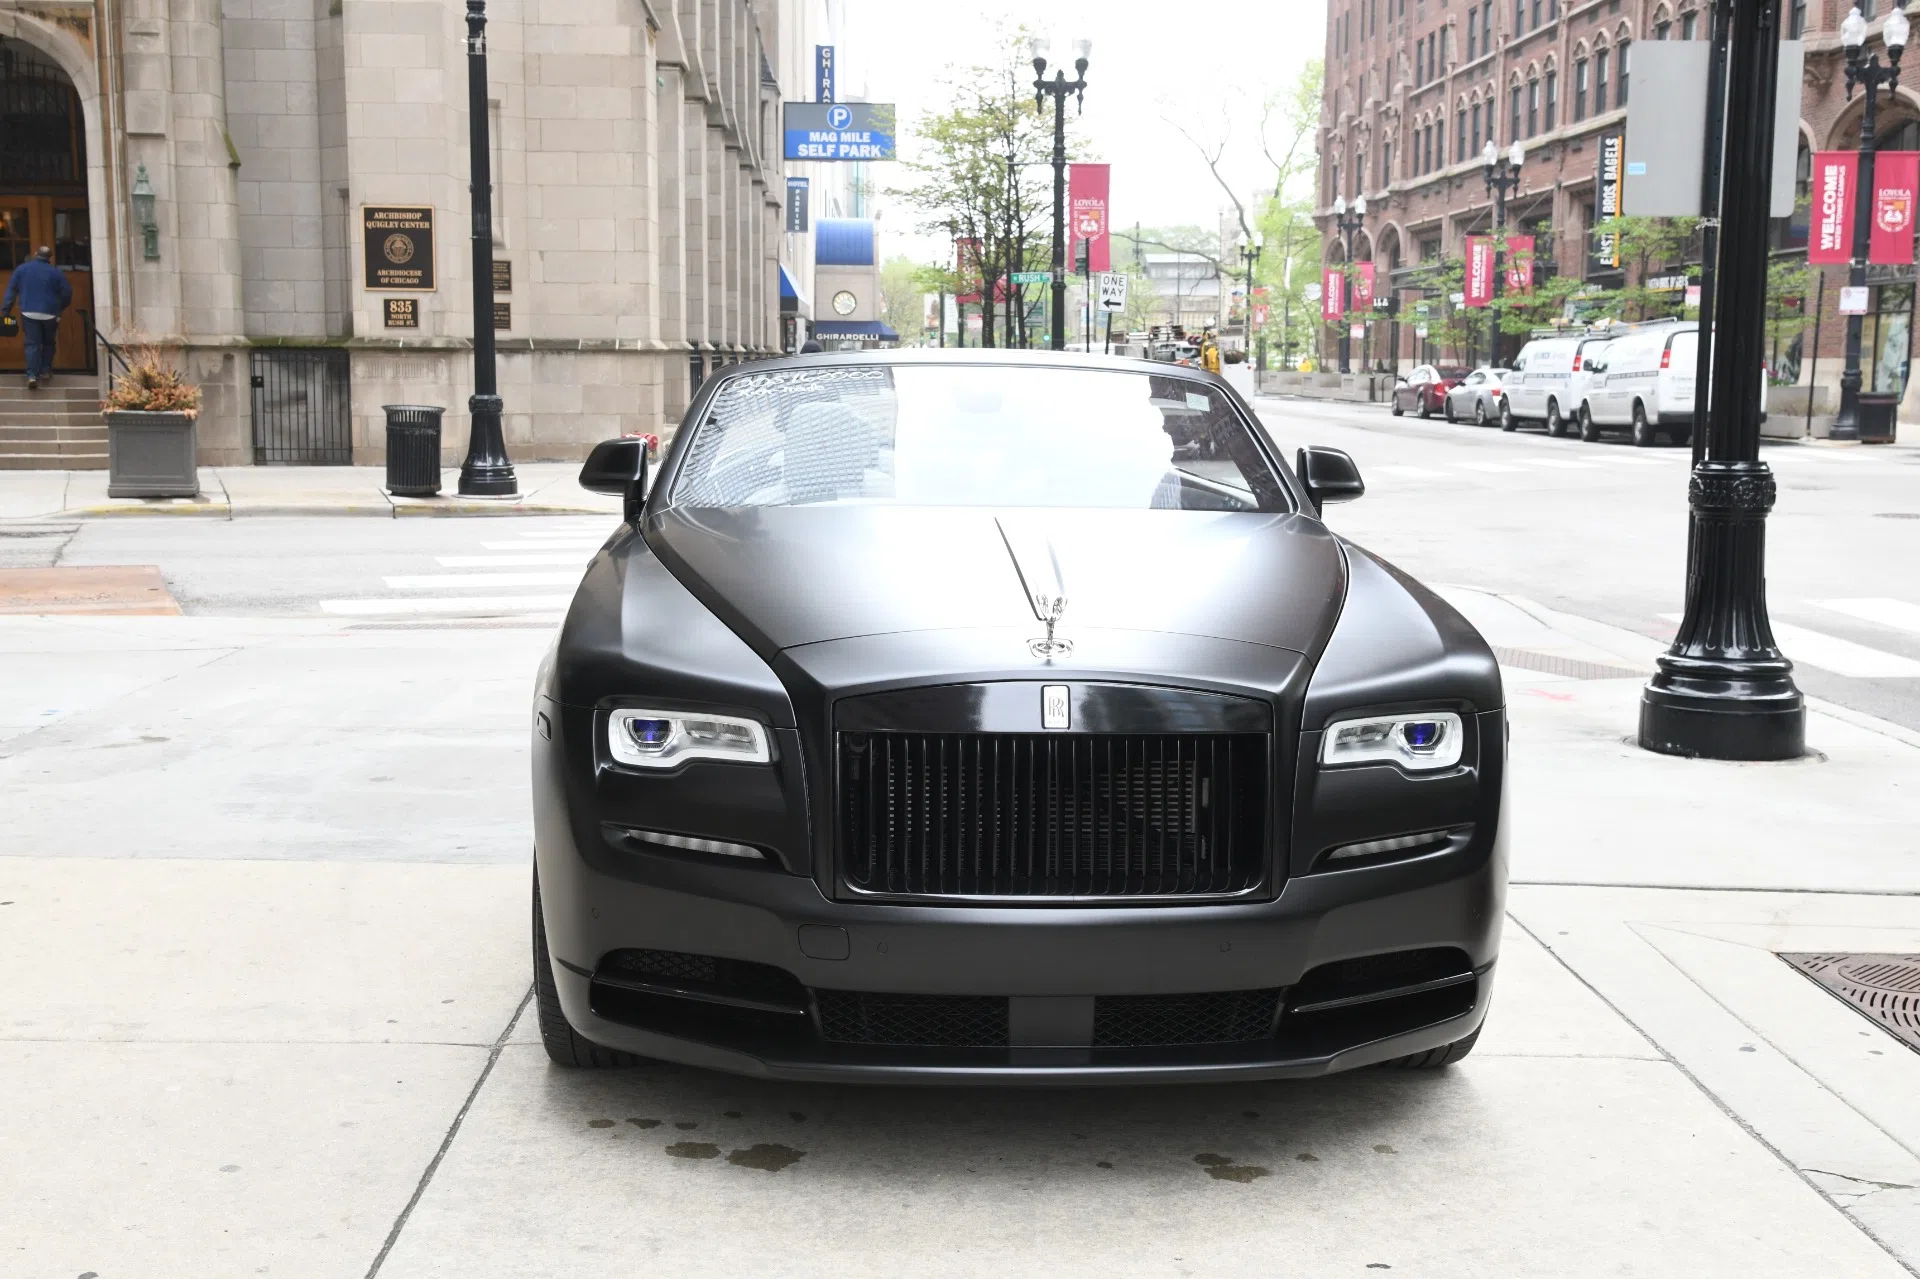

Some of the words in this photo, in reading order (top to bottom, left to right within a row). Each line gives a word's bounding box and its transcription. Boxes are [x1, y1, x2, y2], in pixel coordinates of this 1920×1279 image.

[833, 108, 848, 127] P
[809, 131, 838, 142] MAG
[840, 131, 872, 143] MILE
[797, 144, 837, 157] SELF
[839, 144, 882, 157] PARK
[1603, 138, 1619, 180] BAGELS
[1837, 165, 1846, 197] CAMPUS
[1878, 188, 1912, 197] LOYOLA
[1073, 199, 1105, 207] LOYOLA
[1820, 164, 1838, 250] WELCOME
[373, 211, 423, 220] ARCHBISHOP
[366, 220, 399, 229] QUIGLEY
[399, 221, 430, 229] CENTER
[376, 269, 423, 277] ARCHDIOCESE
[1471, 244, 1482, 298] WELCOME
[1018, 274, 1041, 283] RUSH
[1103, 275, 1125, 287] ONE
[1101, 286, 1124, 297] WAY
[1328, 273, 1336, 314] WELCOME
[390, 300, 412, 313] 835
[816, 333, 880, 341] GHIRARDELLI
